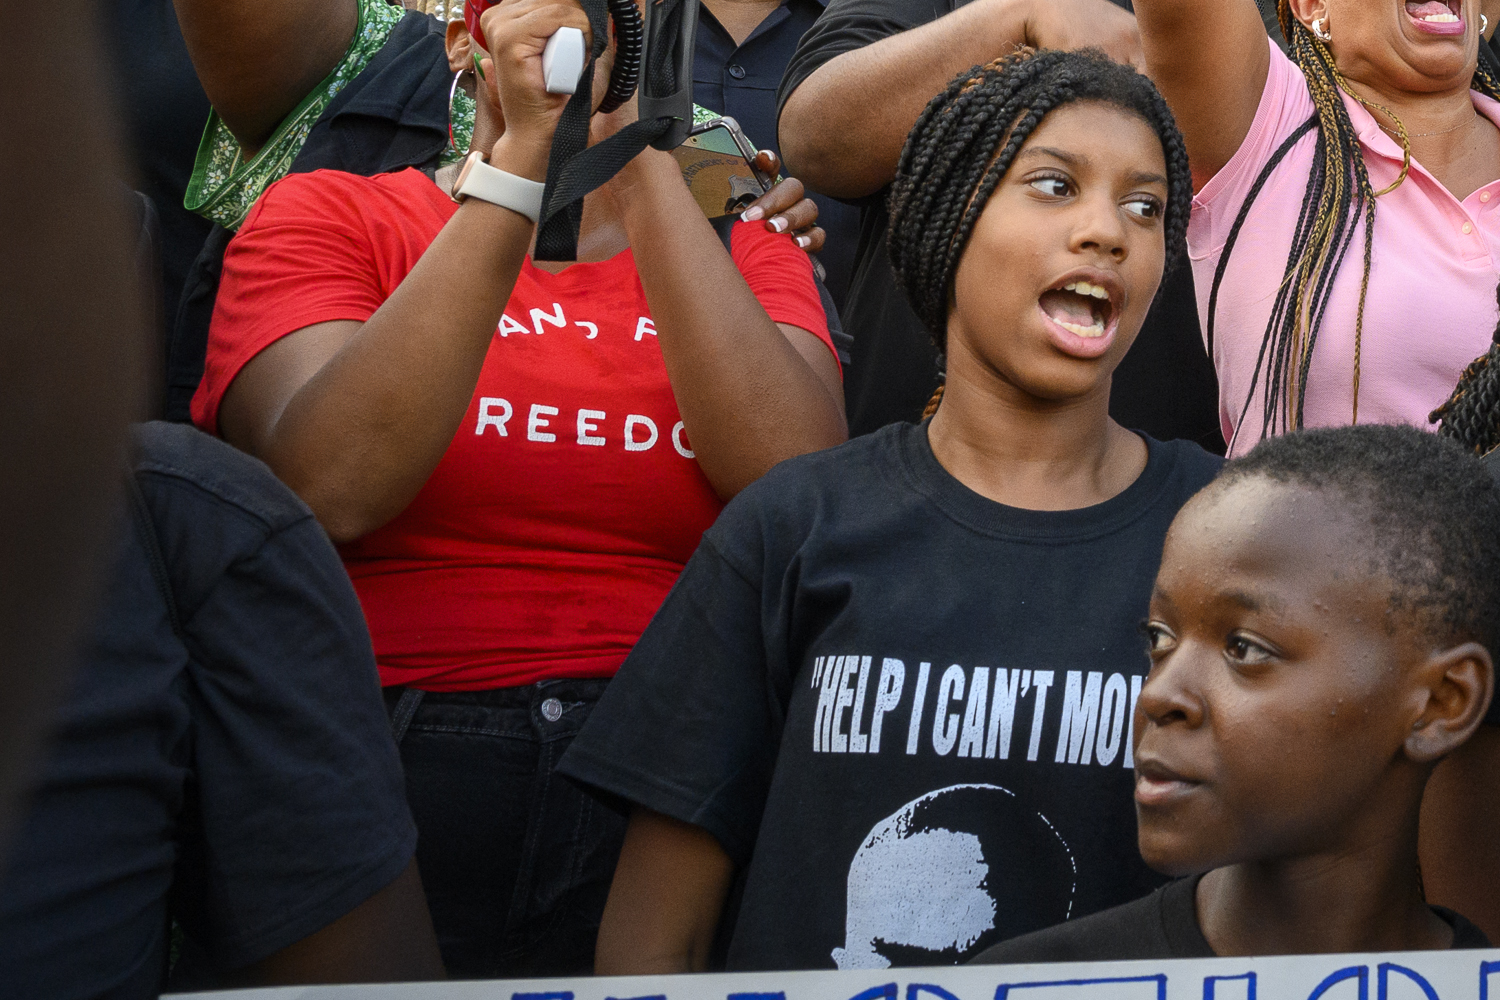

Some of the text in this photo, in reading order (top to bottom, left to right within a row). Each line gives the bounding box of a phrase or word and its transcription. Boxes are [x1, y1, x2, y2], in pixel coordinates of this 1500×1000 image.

[811, 655, 906, 754] "HELP
[906, 661, 931, 755] I
[932, 663, 1055, 762] CAN'T
